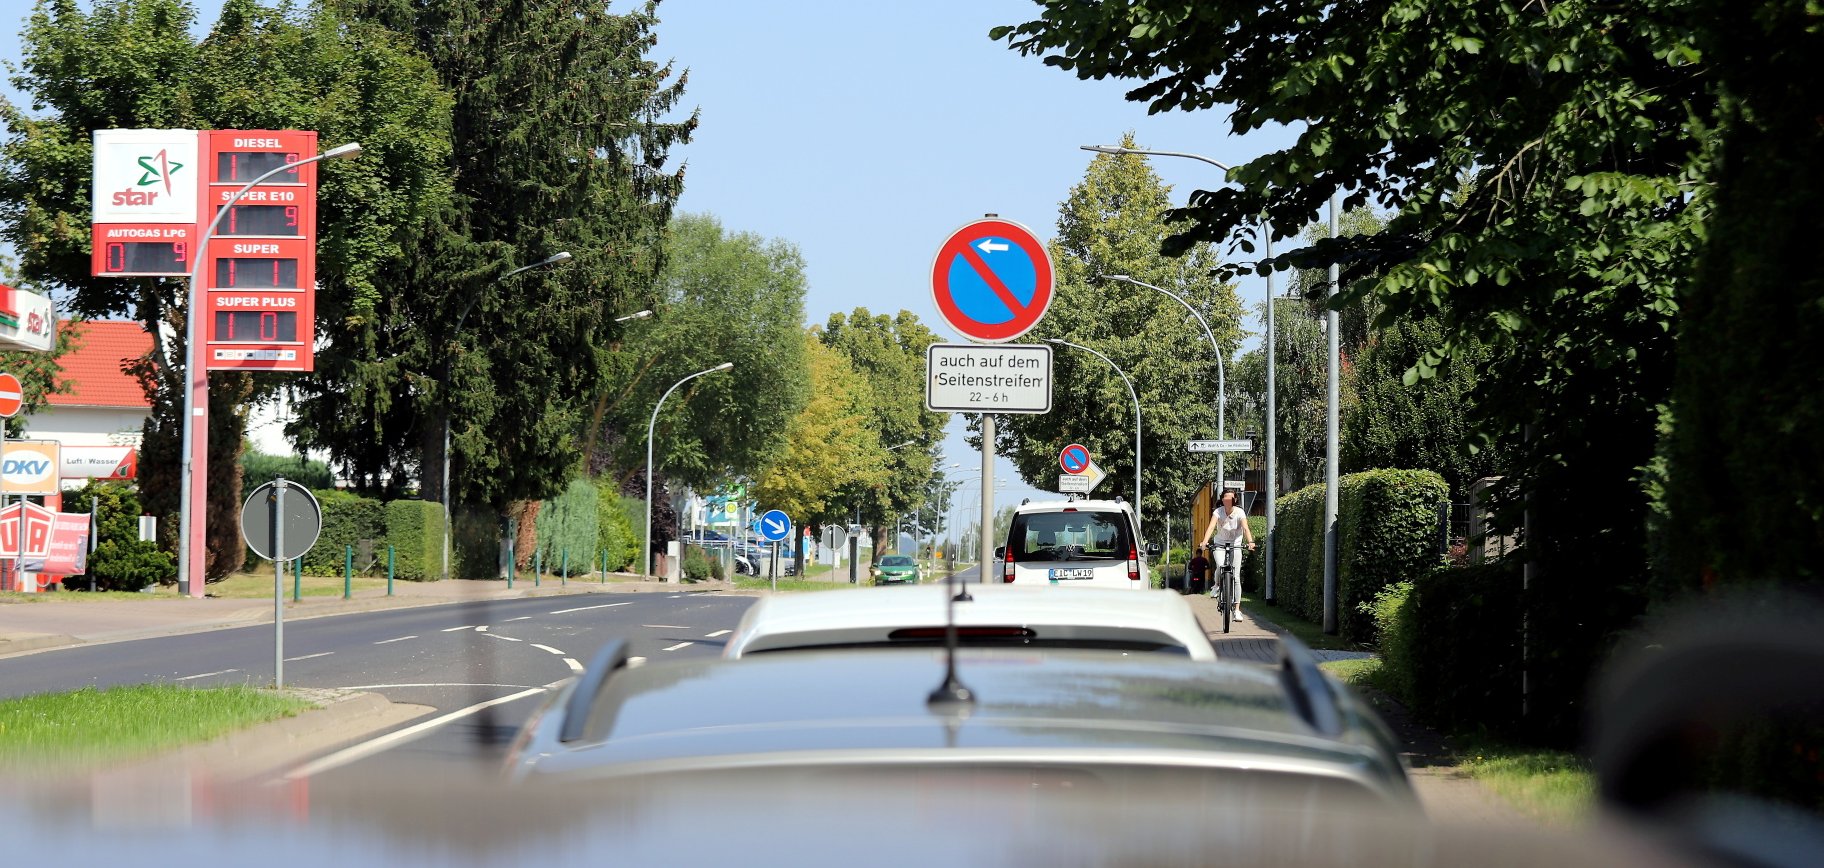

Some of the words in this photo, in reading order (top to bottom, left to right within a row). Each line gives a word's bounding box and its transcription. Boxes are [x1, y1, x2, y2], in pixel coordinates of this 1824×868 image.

[233, 138, 282, 148] DIESEL
[112, 187, 158, 206] star
[270, 191, 294, 201] E10
[107, 229, 160, 238] AUTOGAS
[163, 229, 186, 238] LPG
[233, 244, 279, 254] SUPER
[216, 297, 259, 307] SUPER
[262, 297, 295, 307] PLUS
[939, 354, 975, 368] auch
[979, 354, 1005, 369] auf
[1008, 355, 1040, 369] dem
[938, 372, 1041, 388] Seitenstreifen
[969, 392, 982, 402] 22
[992, 392, 999, 402] 6
[1001, 392, 1009, 403] h
[66, 457, 83, 465] Luft
[3, 459, 49, 475] DKV
